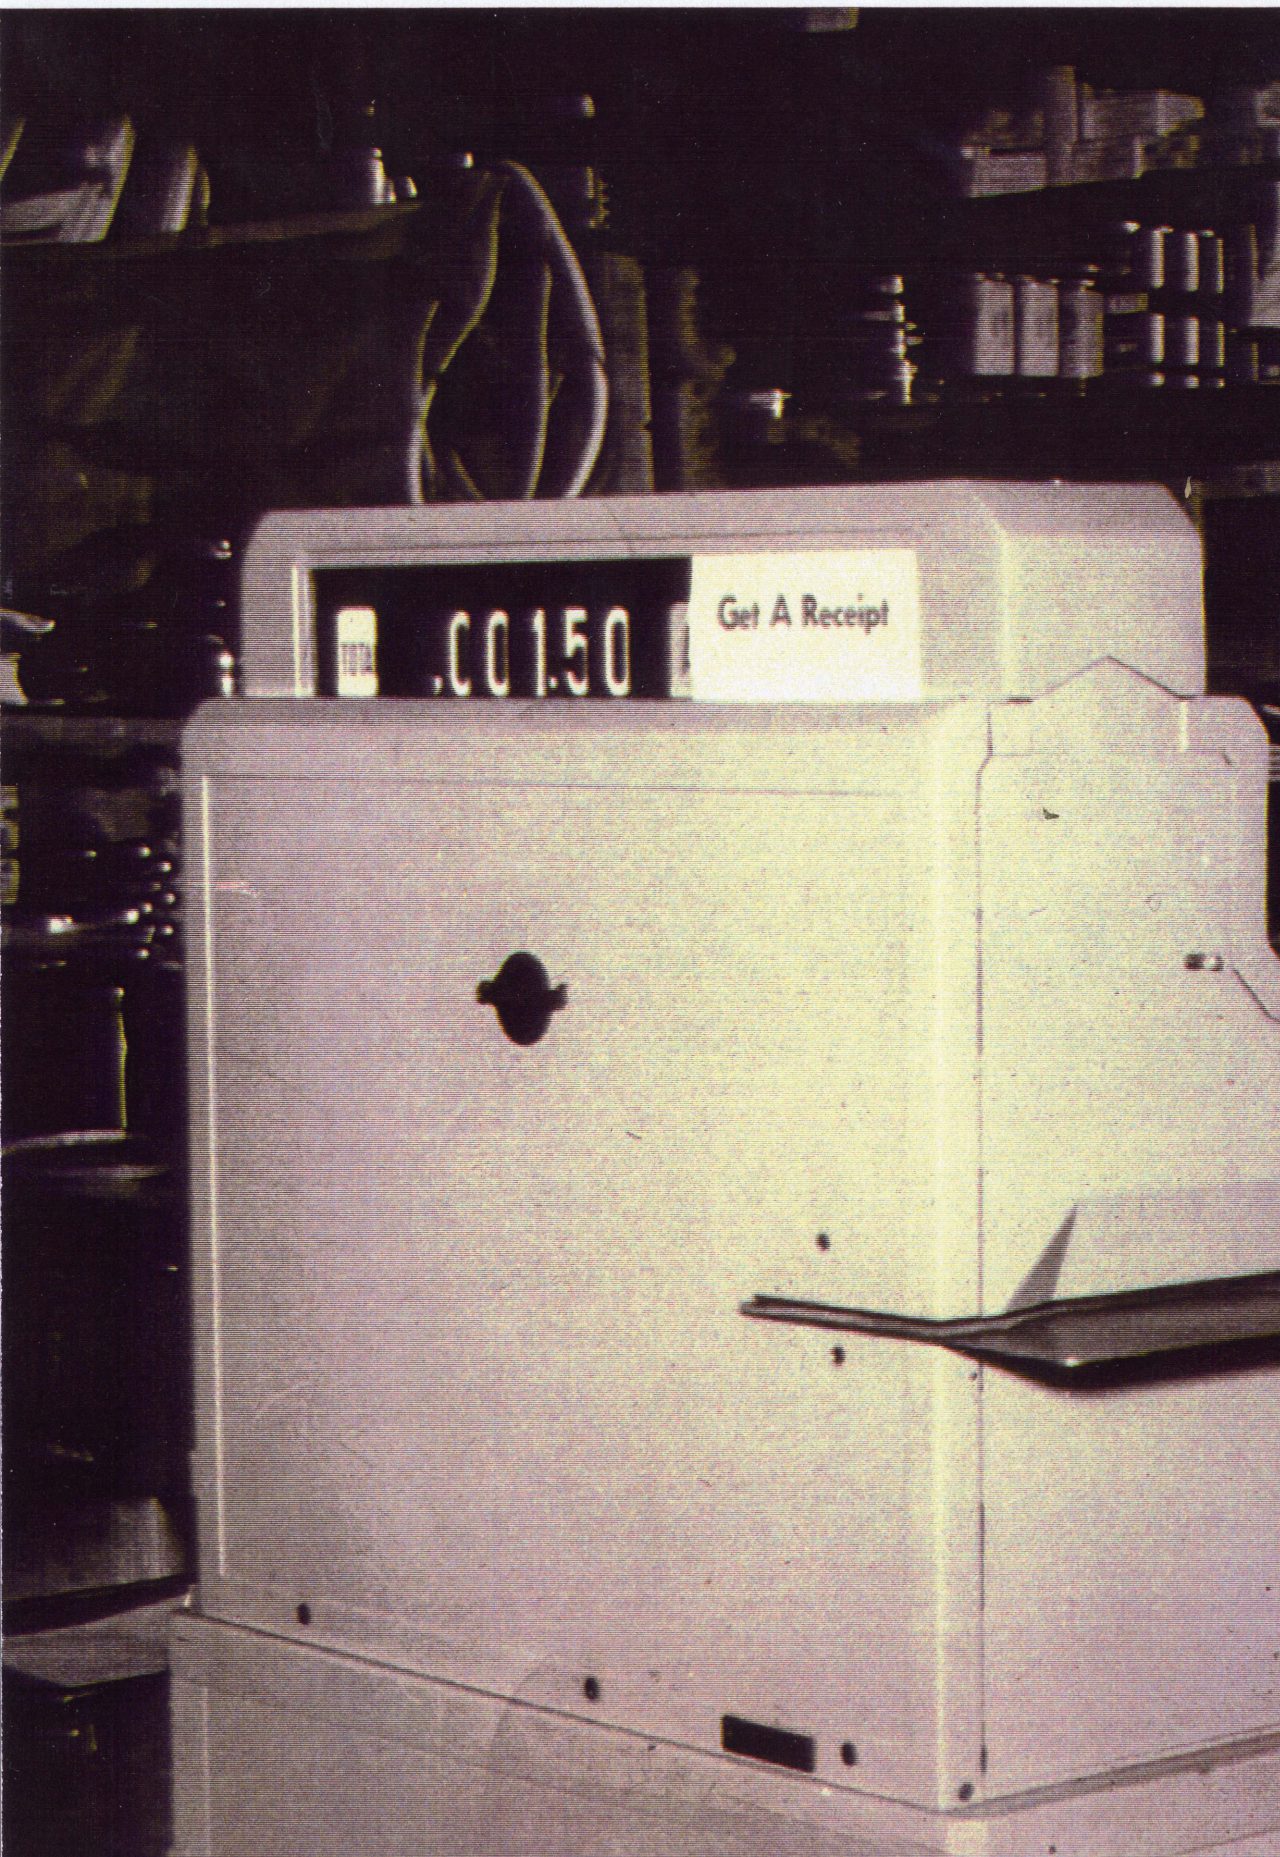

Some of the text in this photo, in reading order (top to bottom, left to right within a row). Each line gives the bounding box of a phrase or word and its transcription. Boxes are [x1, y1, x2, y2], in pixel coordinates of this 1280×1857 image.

[717, 591, 889, 635] Get A Receipt
